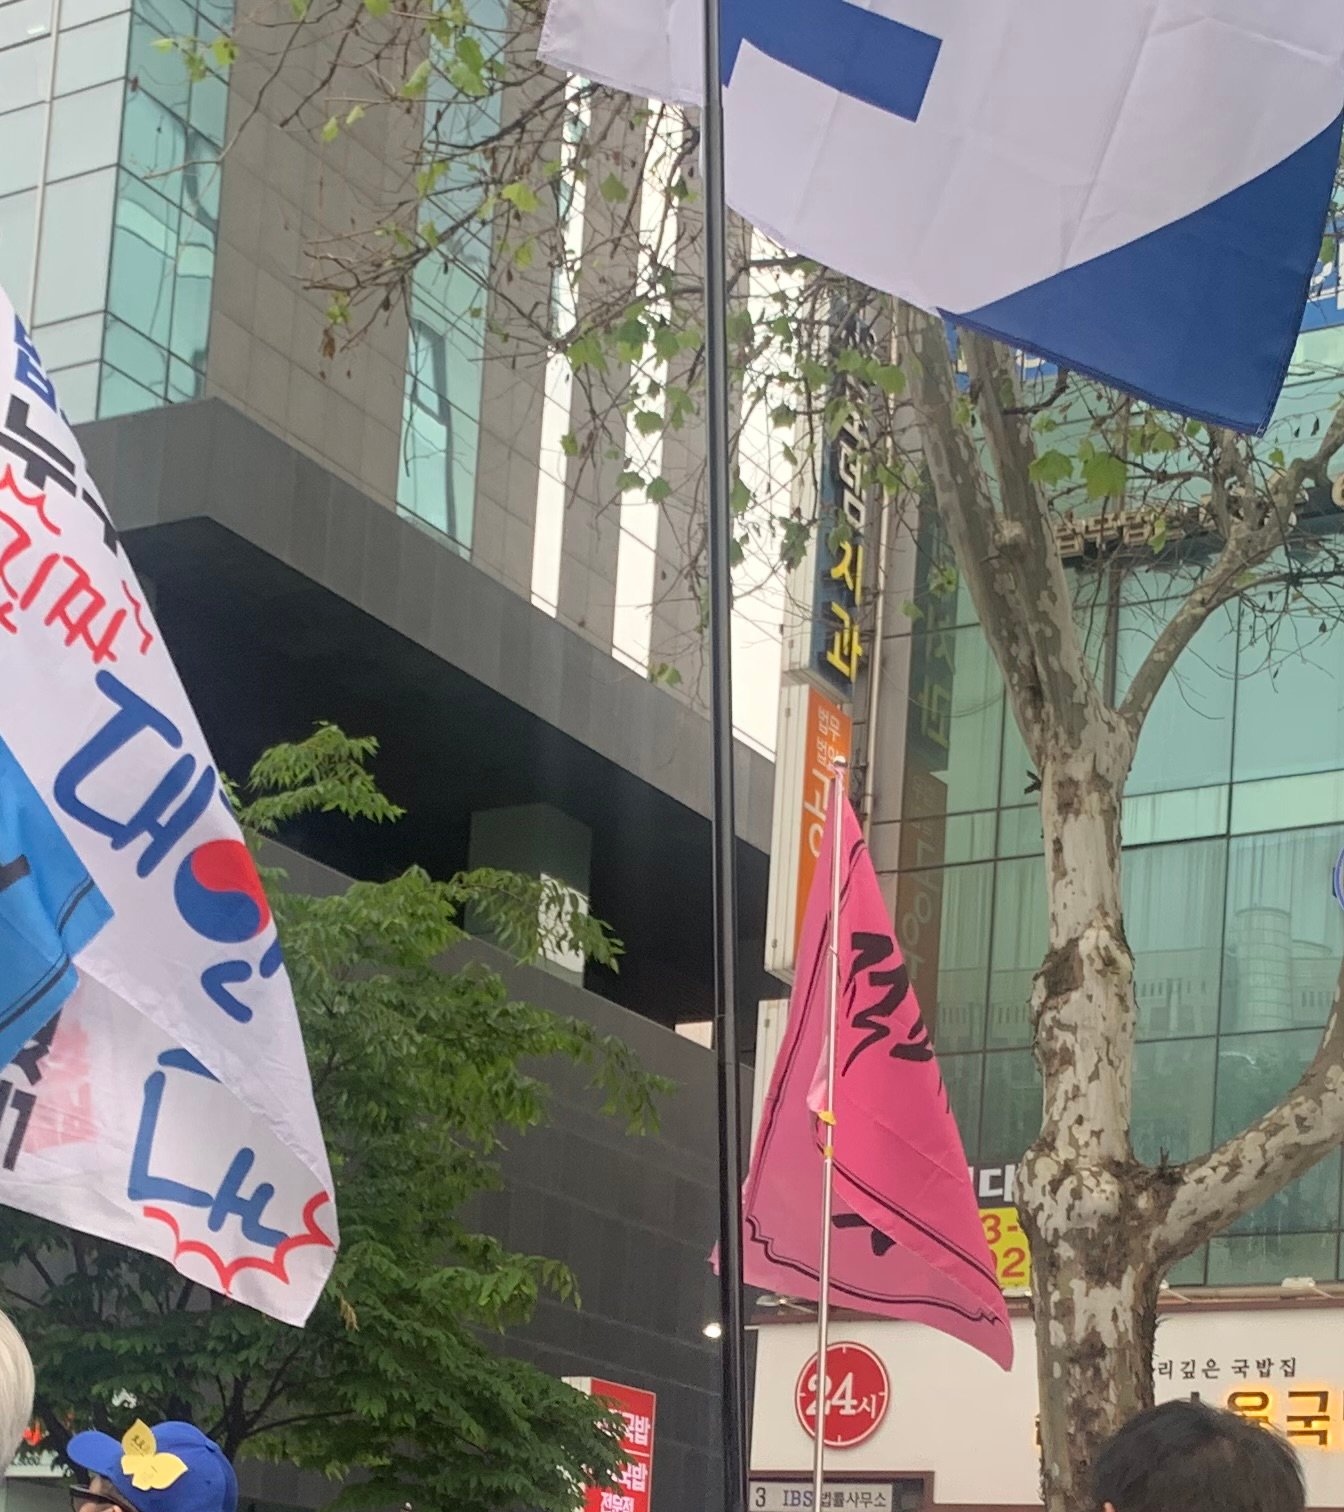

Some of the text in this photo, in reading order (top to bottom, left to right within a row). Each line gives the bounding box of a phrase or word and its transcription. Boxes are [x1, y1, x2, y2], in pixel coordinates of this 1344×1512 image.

[816, 704, 843, 742] 법무
[1157, 1356, 1297, 1381] 리깊은 국밥집
[805, 1371, 877, 1420] 24시
[755, 1487, 887, 1509] 3 IBS 법률사무소
